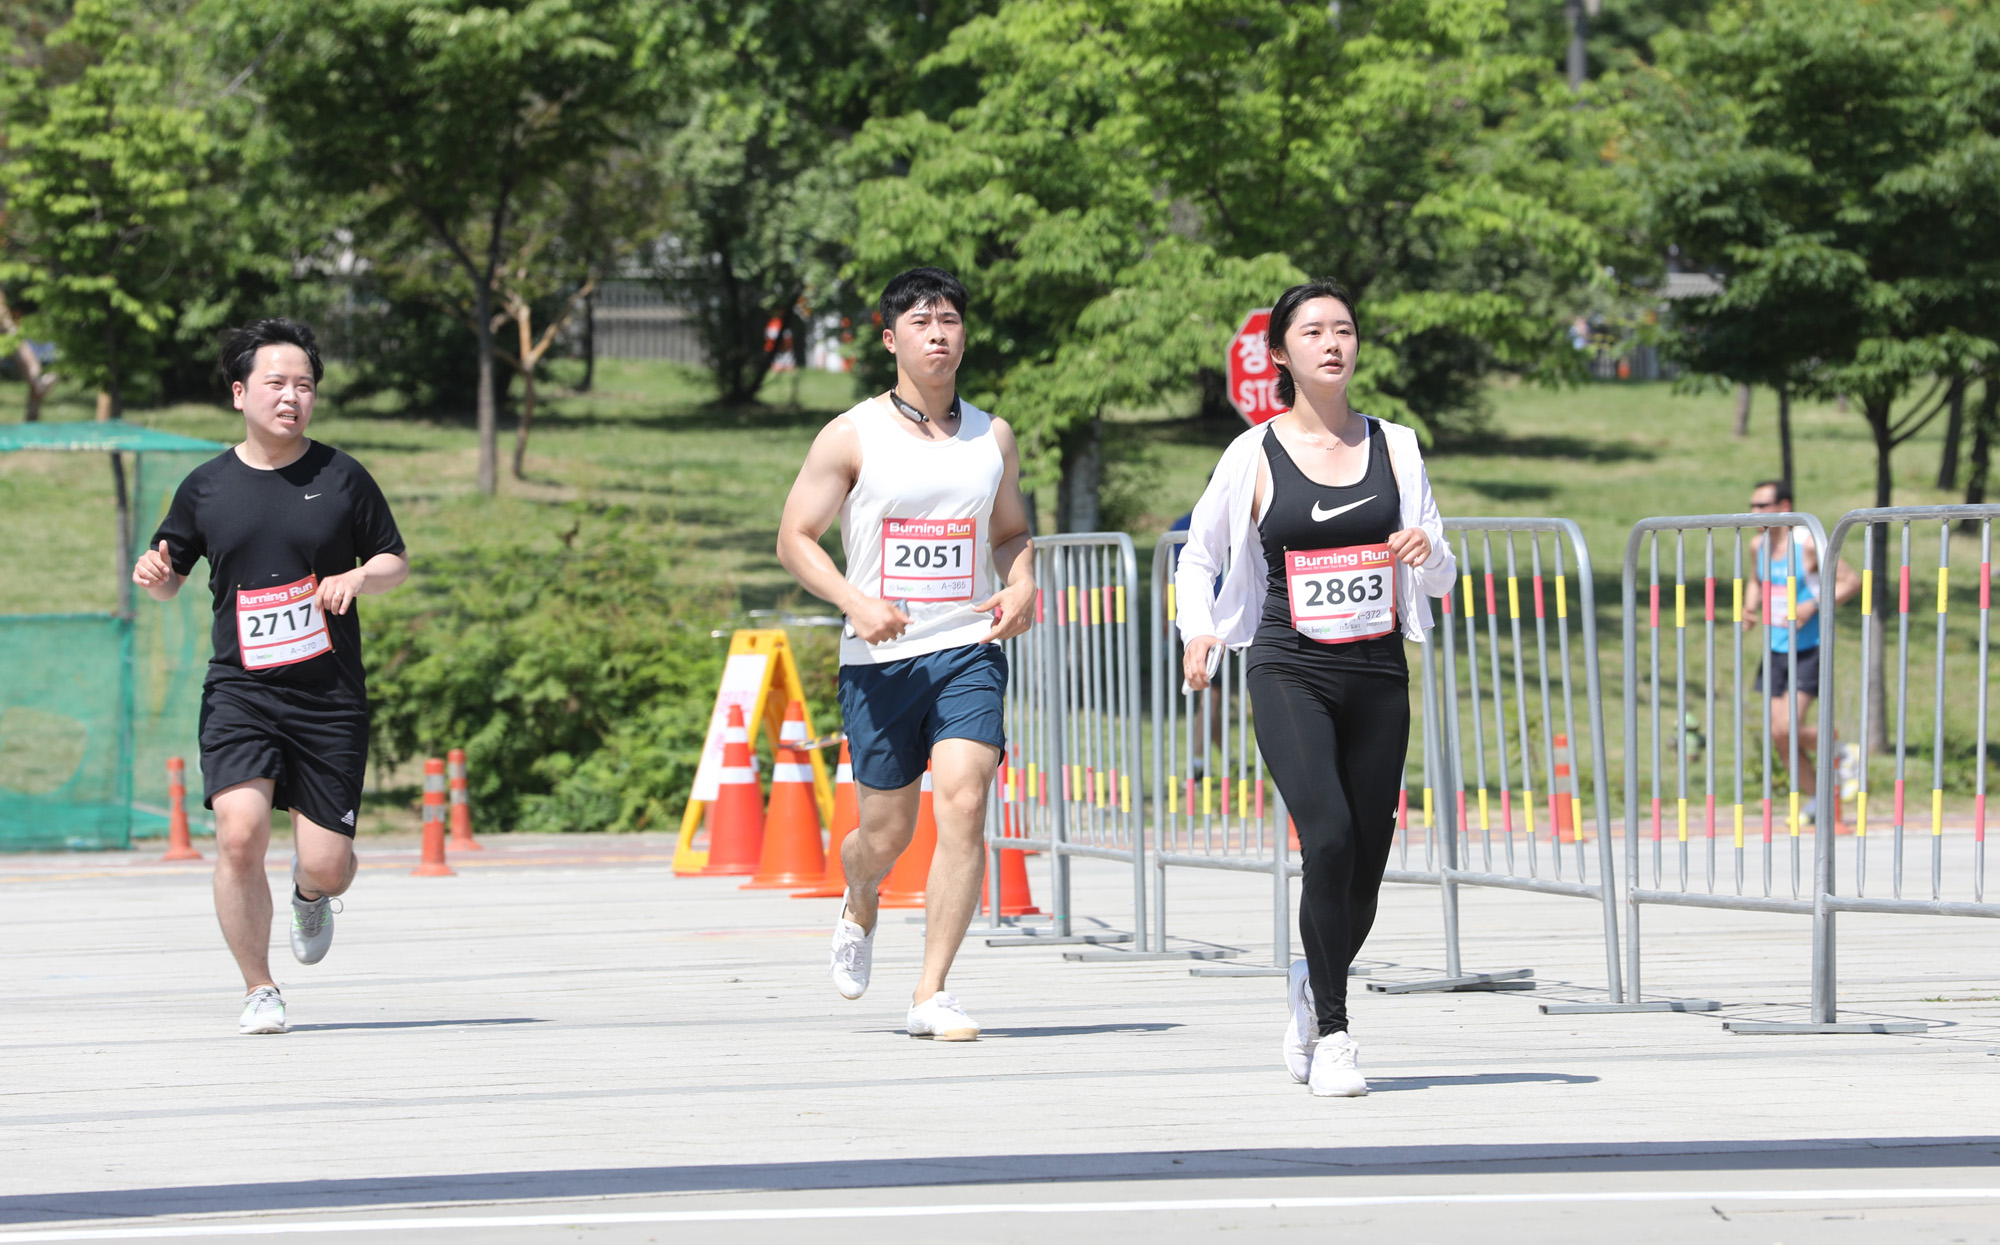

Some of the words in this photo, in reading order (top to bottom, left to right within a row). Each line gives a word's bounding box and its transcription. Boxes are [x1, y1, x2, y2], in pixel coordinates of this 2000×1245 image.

[1238, 331, 1268, 374] 정
[1239, 379, 1286, 413] STO
[889, 523, 944, 536] Burning
[947, 523, 970, 534] Run
[895, 545, 961, 568] 2051
[1295, 553, 1358, 567] Burning
[1361, 550, 1390, 562] Run
[240, 591, 288, 605] Burning
[289, 582, 313, 597] Run
[941, 581, 966, 590] A-365
[1305, 575, 1383, 606] 2863
[247, 603, 311, 638] 2717
